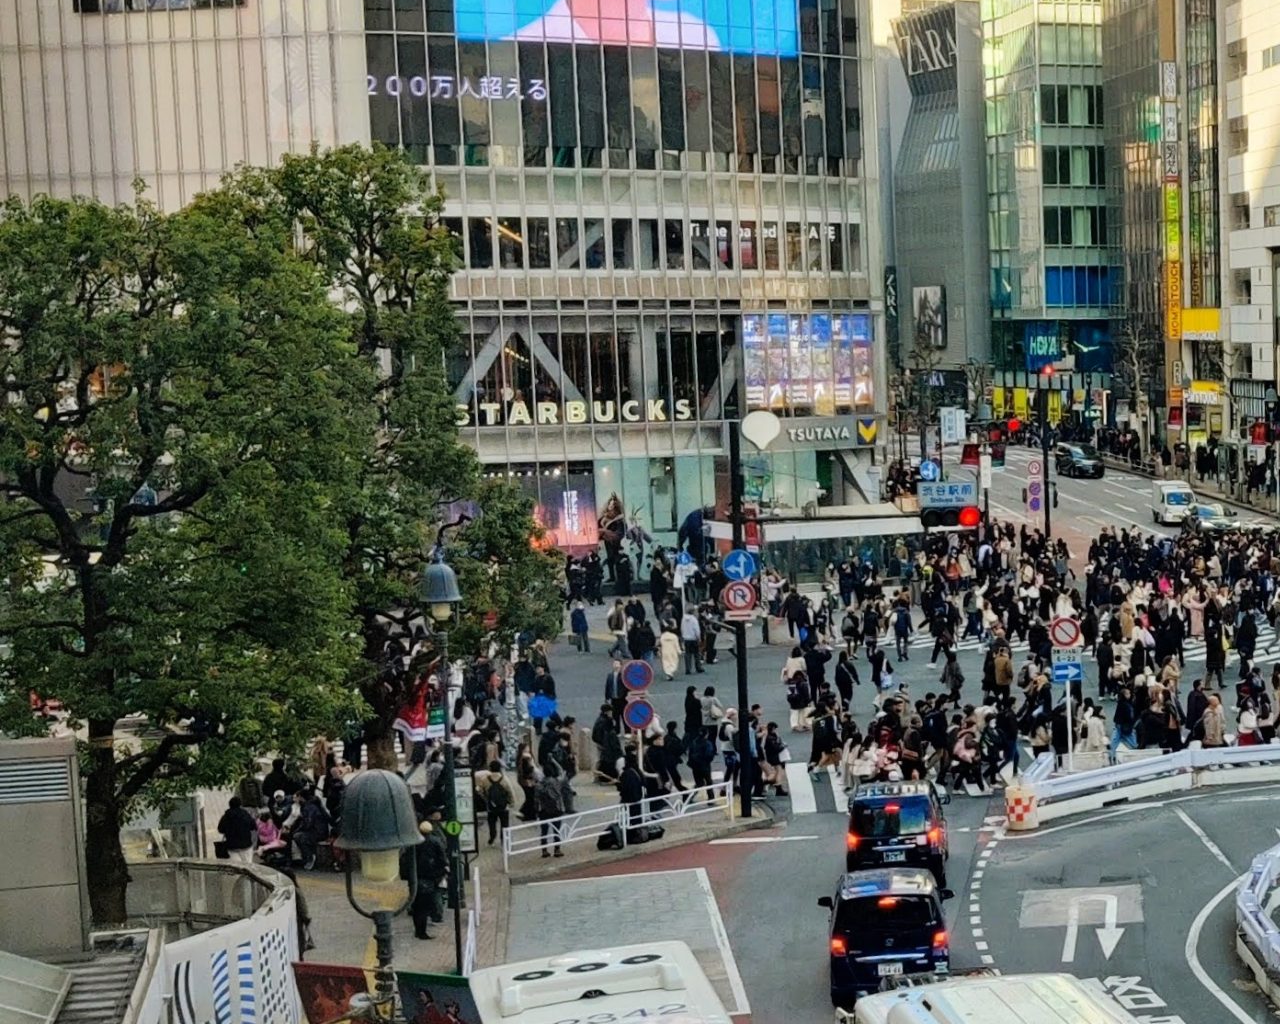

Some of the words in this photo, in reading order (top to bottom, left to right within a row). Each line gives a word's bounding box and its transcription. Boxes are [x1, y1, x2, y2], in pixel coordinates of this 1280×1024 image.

[886, 274, 897, 316] ZARA
[455, 399, 692, 426] STARBUCKS
[788, 426, 851, 442] TSUTAYA
